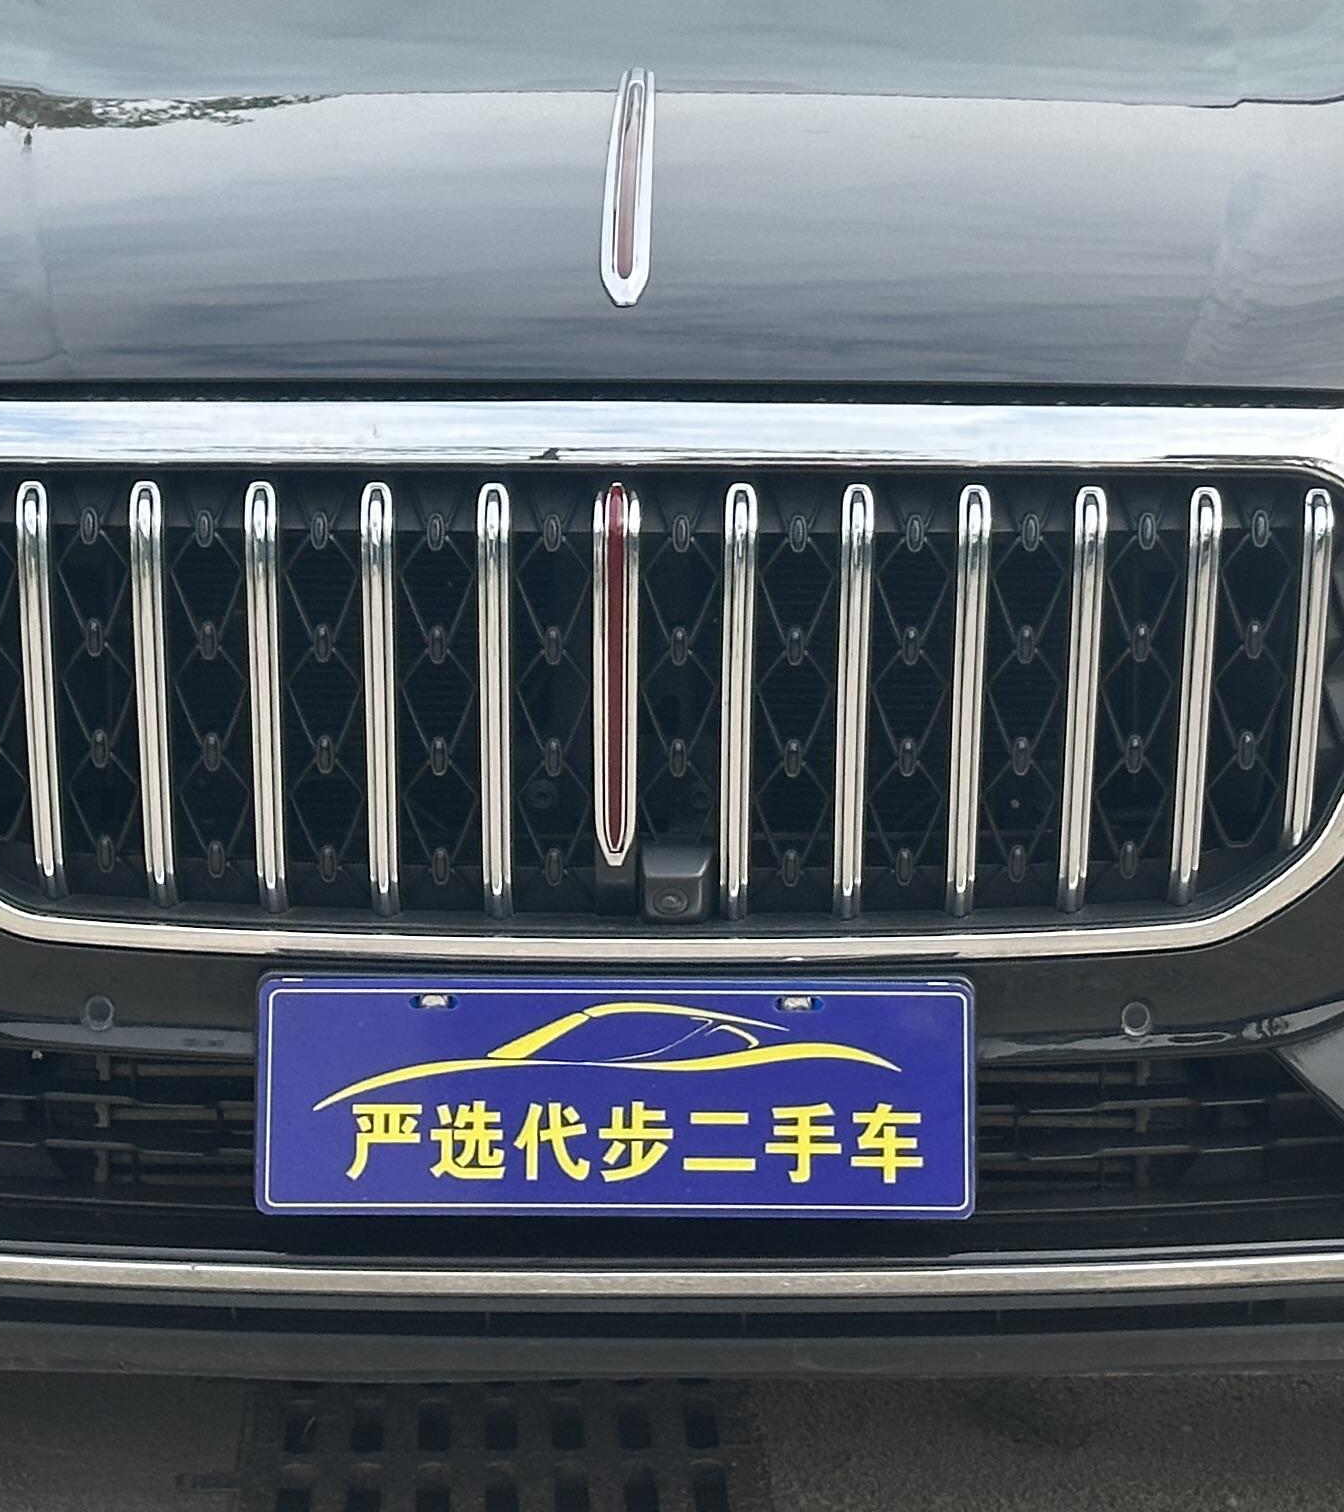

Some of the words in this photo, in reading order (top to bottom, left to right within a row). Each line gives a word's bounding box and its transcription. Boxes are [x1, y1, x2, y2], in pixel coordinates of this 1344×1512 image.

[345, 1100, 924, 1184] 严选代步二手车
